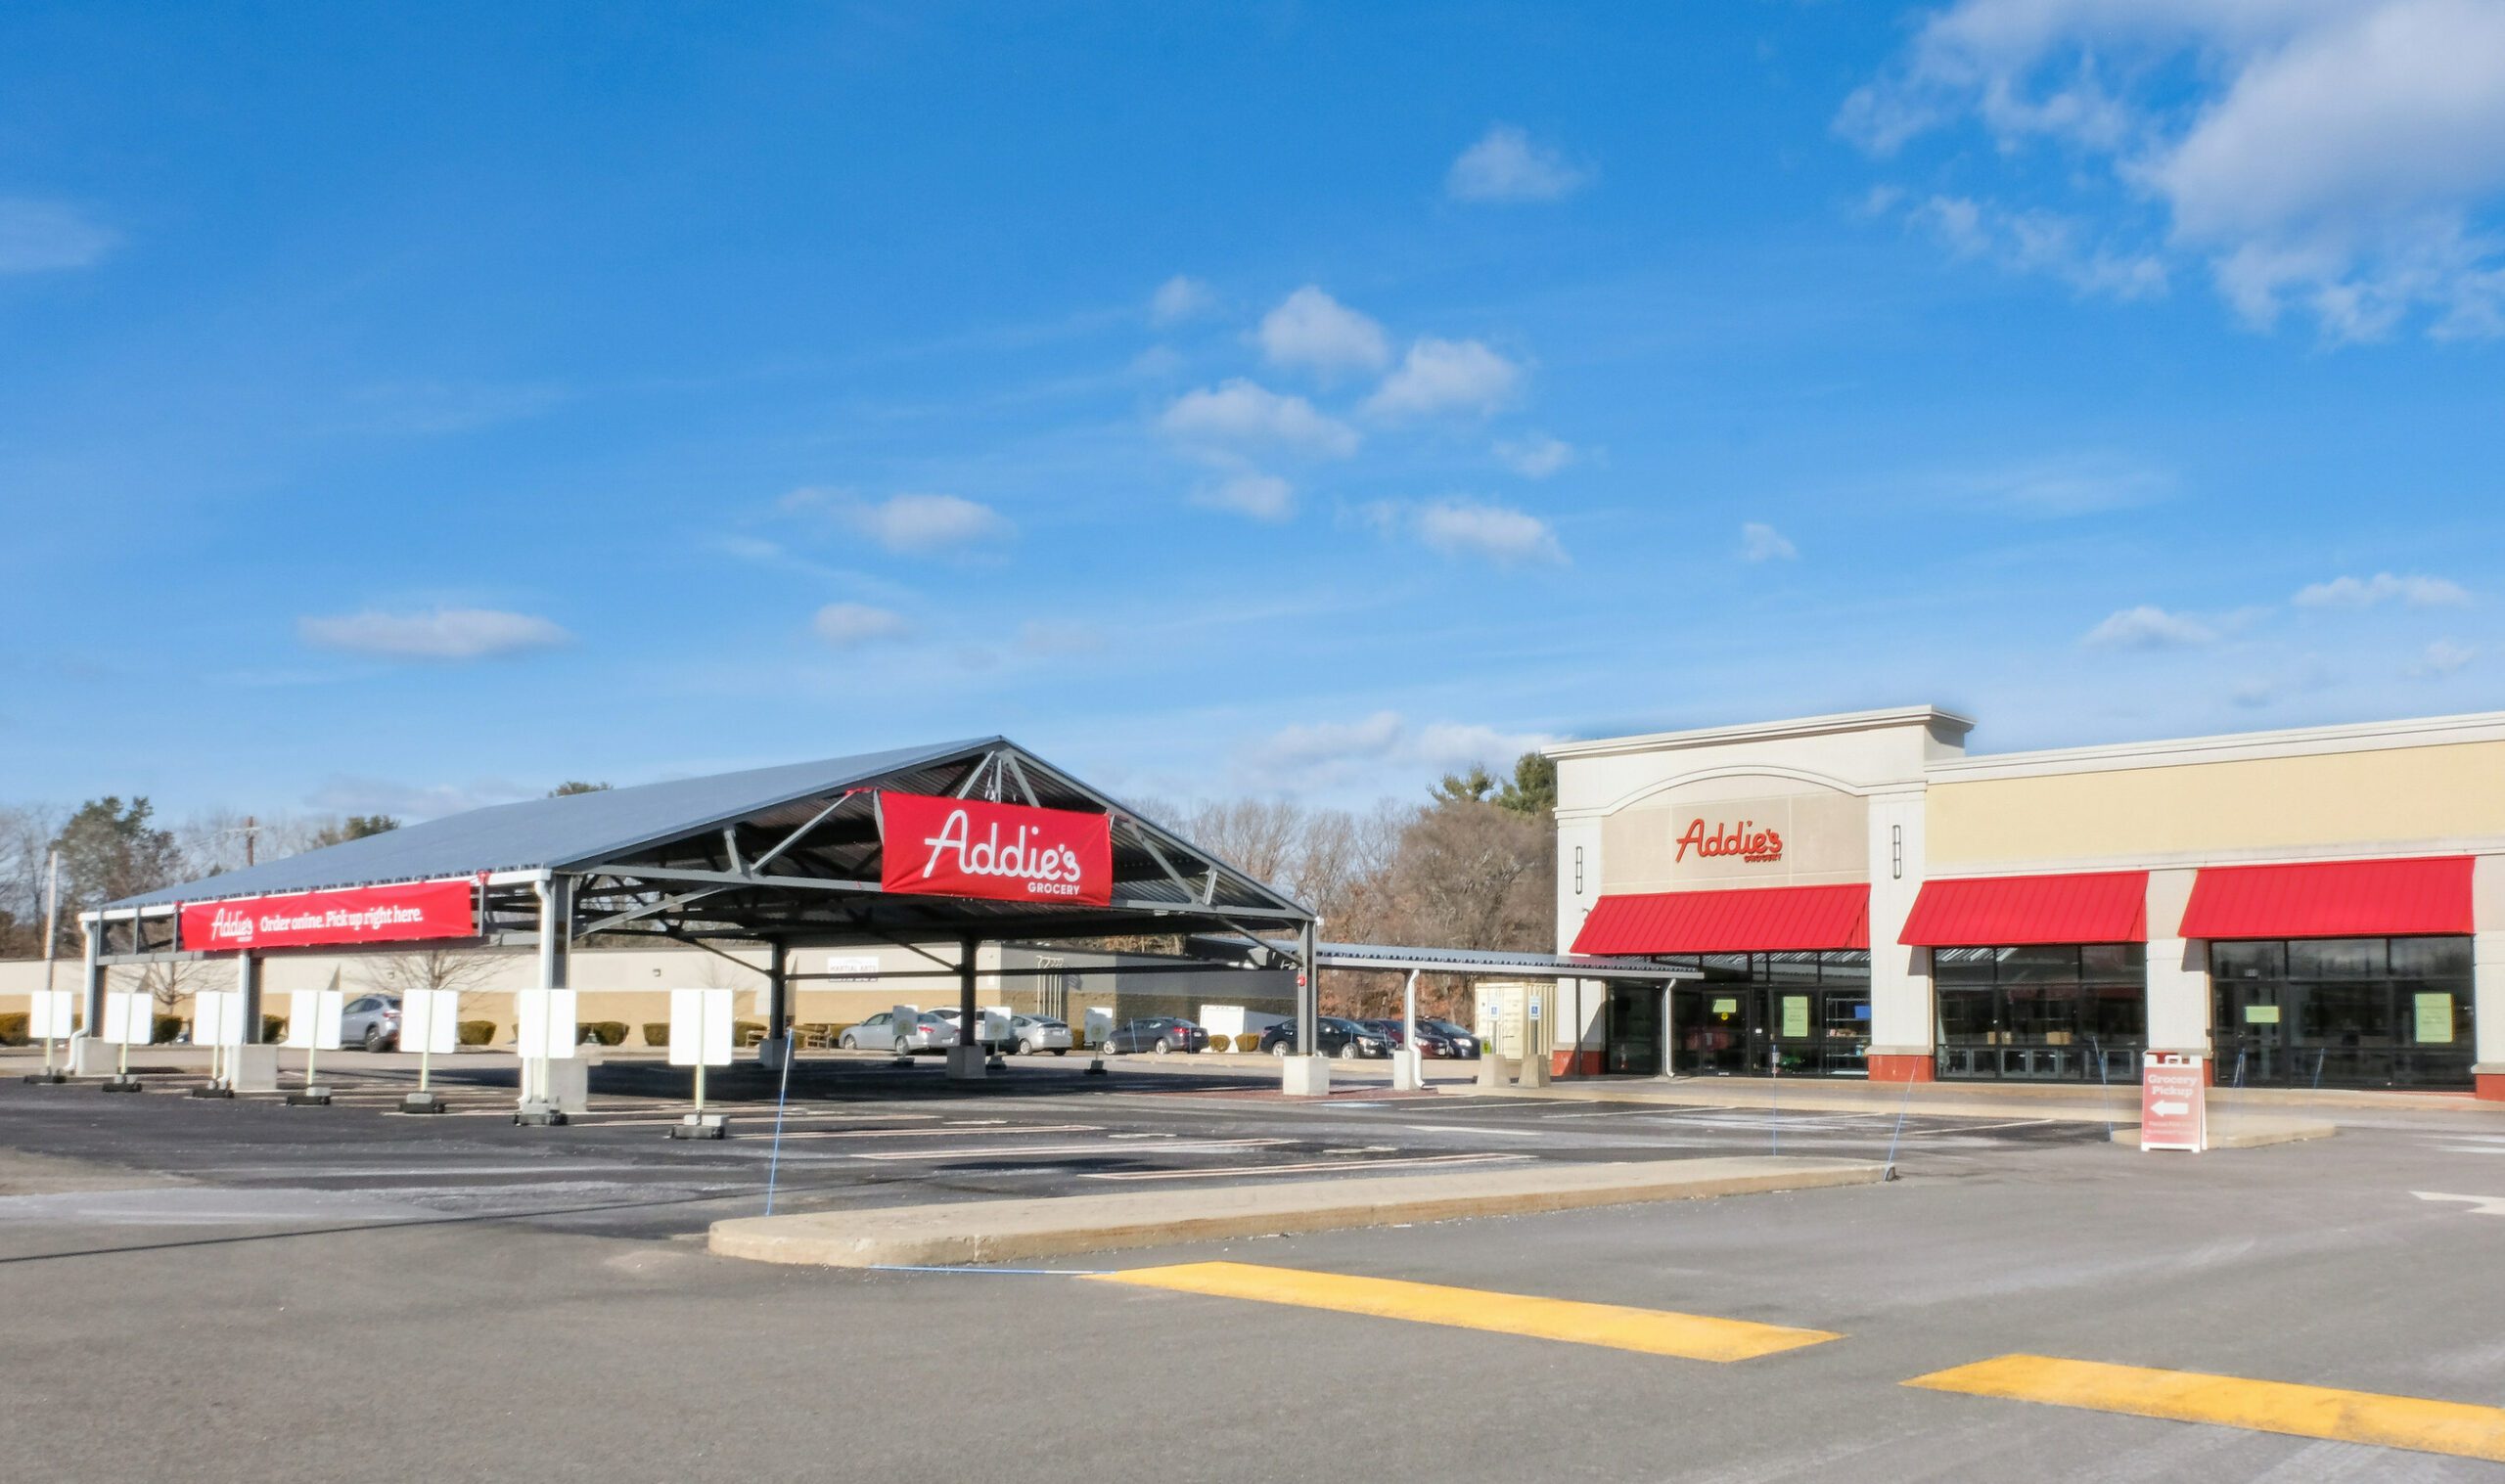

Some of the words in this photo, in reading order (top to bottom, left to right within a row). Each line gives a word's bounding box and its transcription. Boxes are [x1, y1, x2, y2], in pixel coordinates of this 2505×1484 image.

[923, 809, 1080, 881] Addie's
[1675, 818, 1783, 863] Addie's
[1027, 881, 1080, 895] GROCERY
[211, 908, 252, 941] Addie's
[260, 915, 291, 932] Order
[291, 912, 324, 929] online.
[326, 910, 348, 927] Pick
[348, 913, 362, 930] up
[364, 906, 392, 929] right
[393, 905, 423, 922] here.
[2148, 1074, 2198, 1086] Grocery
[2153, 1085, 2193, 1098] Pickup
